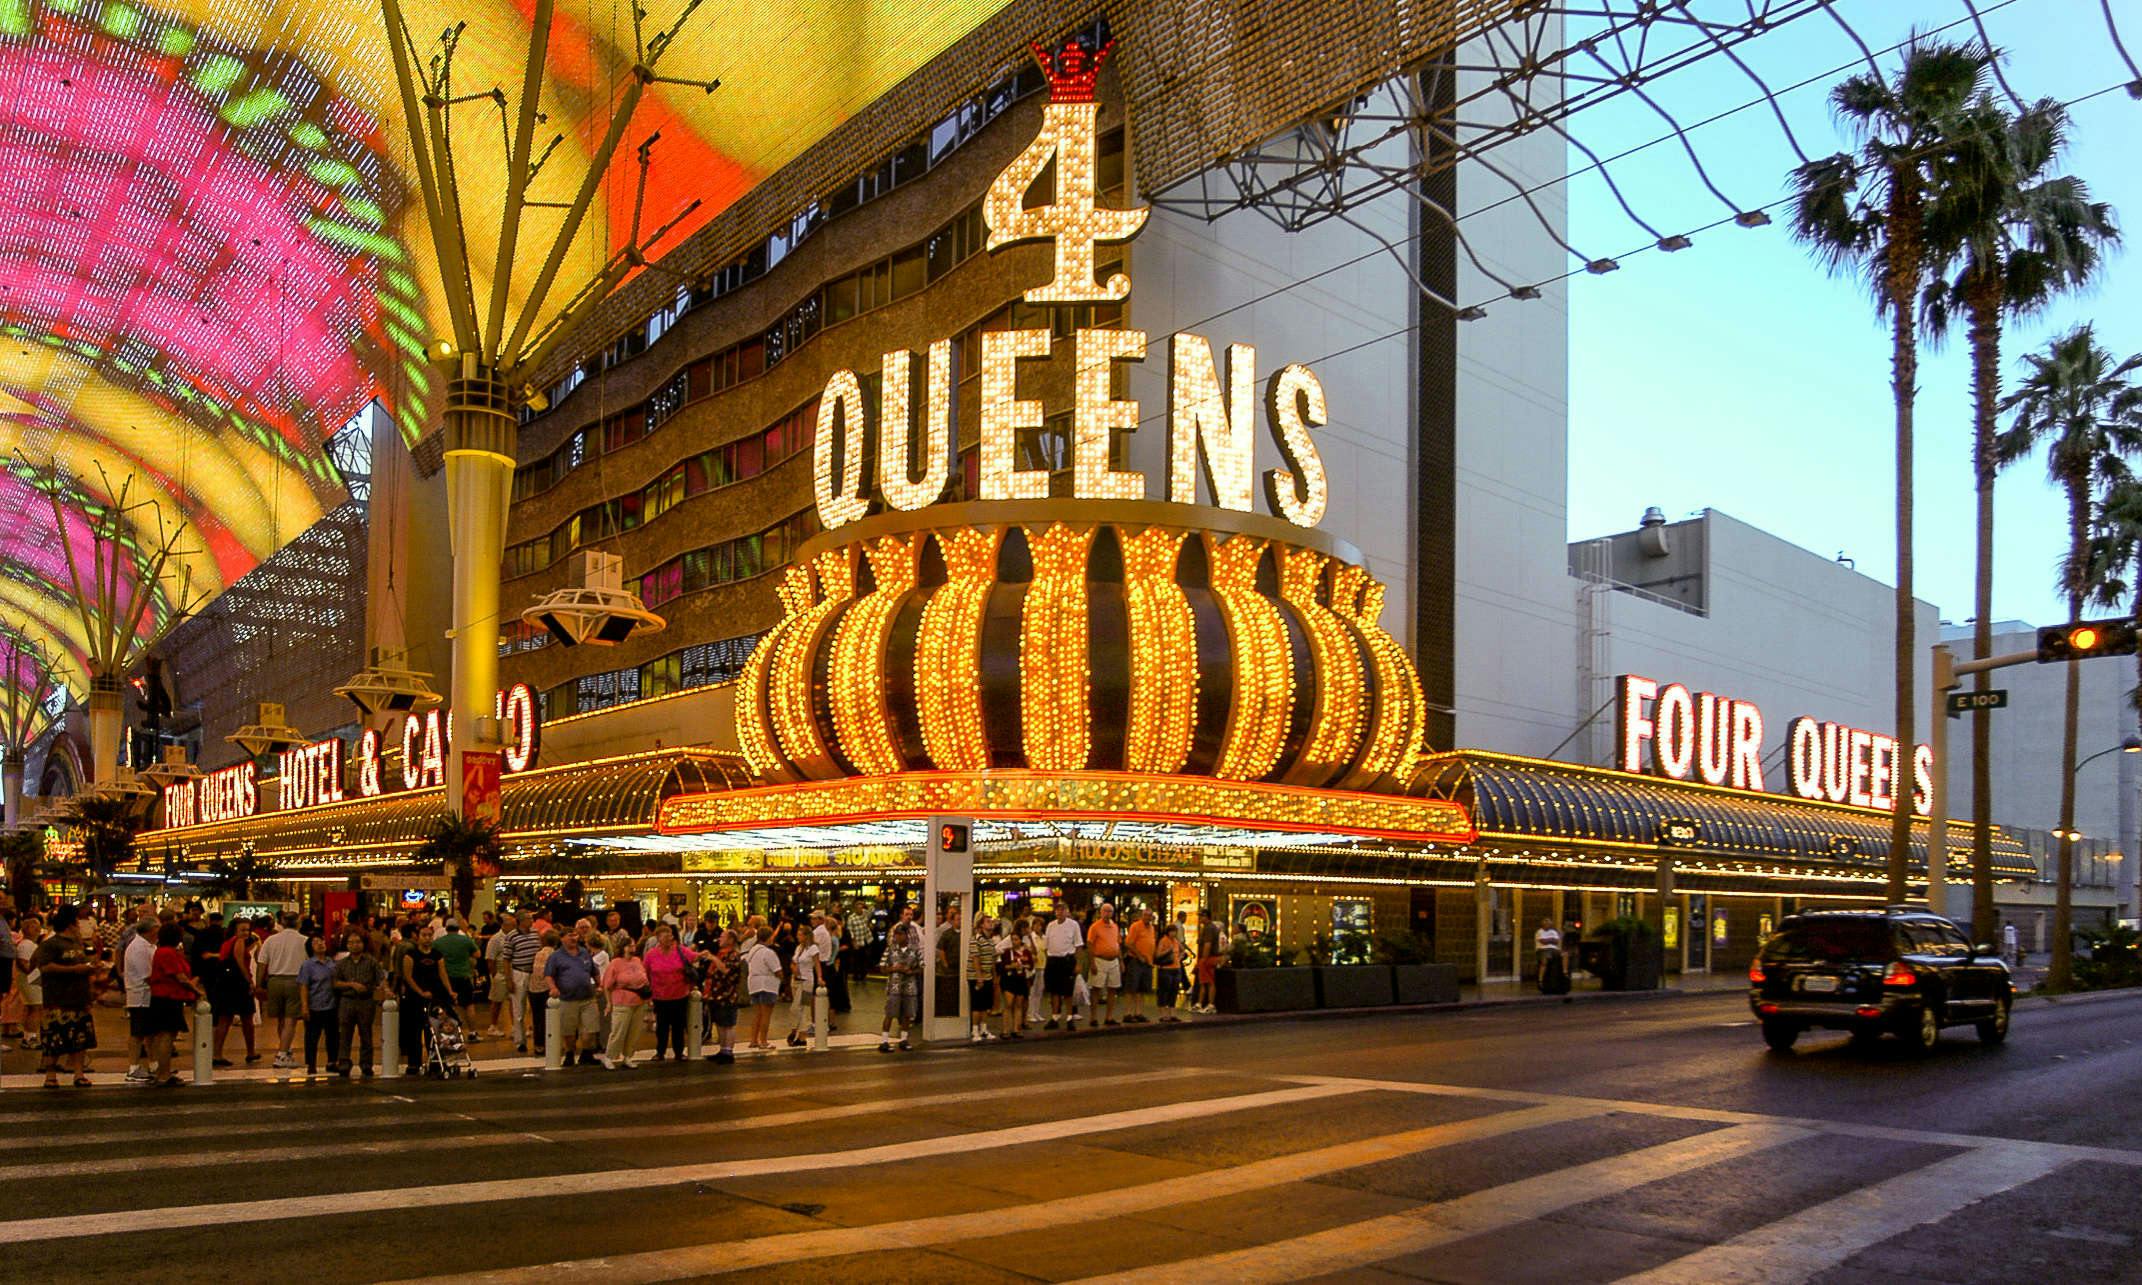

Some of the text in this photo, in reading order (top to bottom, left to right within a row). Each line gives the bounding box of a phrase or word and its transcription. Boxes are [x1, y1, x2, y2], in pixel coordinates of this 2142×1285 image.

[982, 103, 1152, 306] 4
[813, 328, 1330, 530] QUEENS
[164, 683, 534, 830] FOUR QUEENS HOTEL & CAO
[1623, 674, 1765, 793] FOUR
[1956, 694, 2000, 707] E 100
